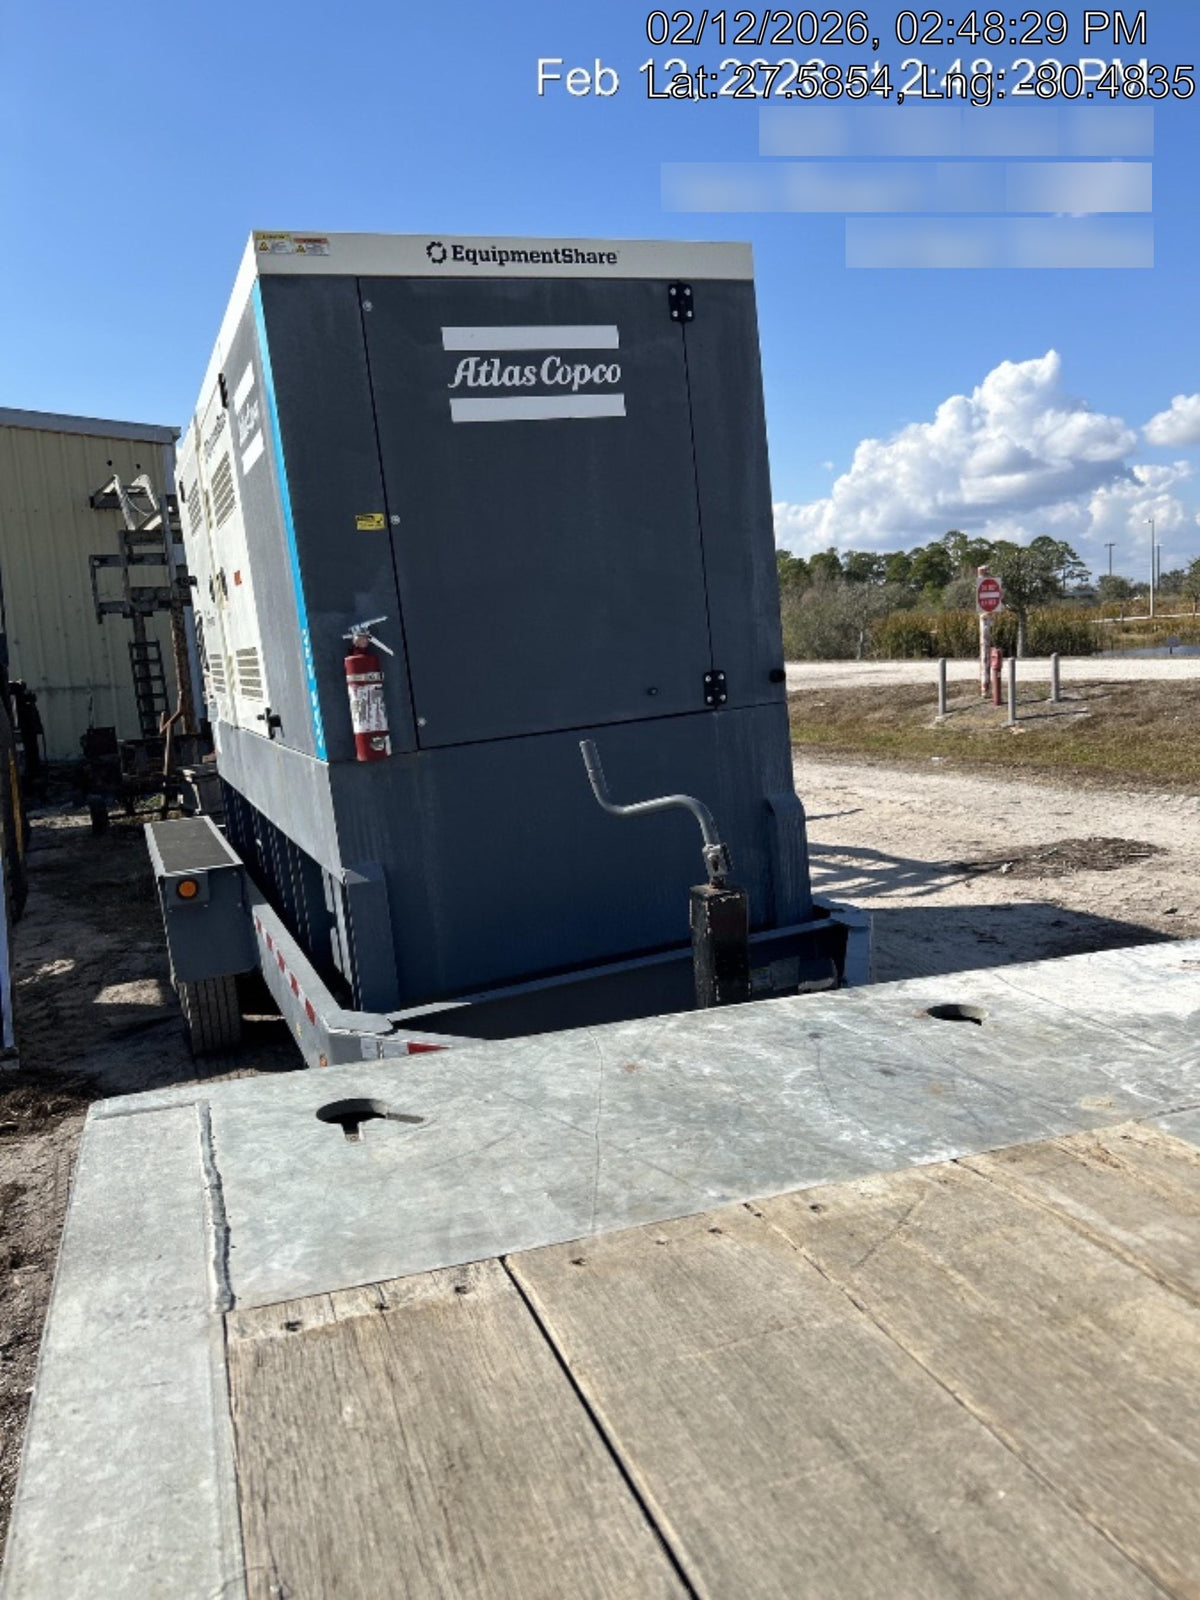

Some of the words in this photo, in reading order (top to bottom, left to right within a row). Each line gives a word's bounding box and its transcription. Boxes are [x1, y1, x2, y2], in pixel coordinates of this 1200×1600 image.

[451, 244, 618, 267] EquipmentShare
[448, 356, 537, 388] Atlas
[540, 356, 622, 391] Copco
